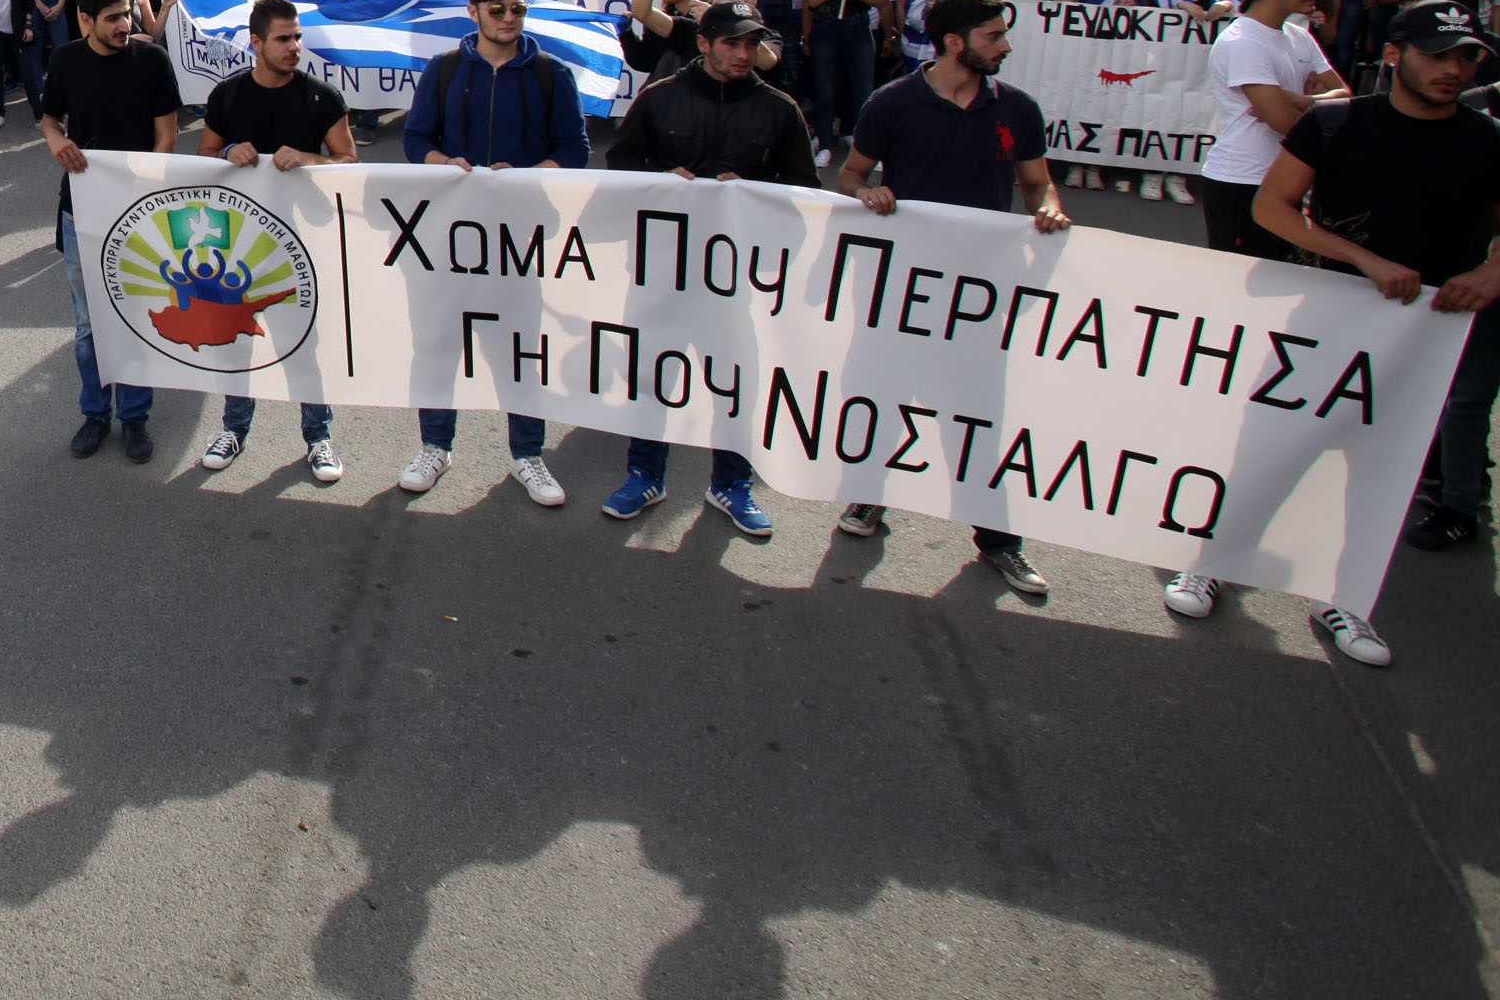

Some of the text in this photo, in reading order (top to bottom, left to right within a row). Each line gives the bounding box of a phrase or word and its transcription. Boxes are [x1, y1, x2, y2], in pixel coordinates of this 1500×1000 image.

[1037, 1, 1239, 45] ΨΕΥΔΟΚΡΑΤ
[1437, 24, 1474, 34] adidas
[1116, 127, 1217, 163] ΠΑΤΡ
[106, 189, 312, 309] ΠΑΓΚΥΠΡΙΑ ΣΥΝΤΟΝΙΣΤΙΚΗ ΕΠΙΤΡΟΠΗ ΜΑΘΗΤΩΝ
[381, 197, 596, 282] ΧΩΜΑ
[825, 232, 1375, 426] ΠΕΡΠΑΤΗΣΑ
[462, 311, 549, 387] ΓΗ
[762, 366, 1227, 541] ΝΟΣΤΑΛΓΩ
